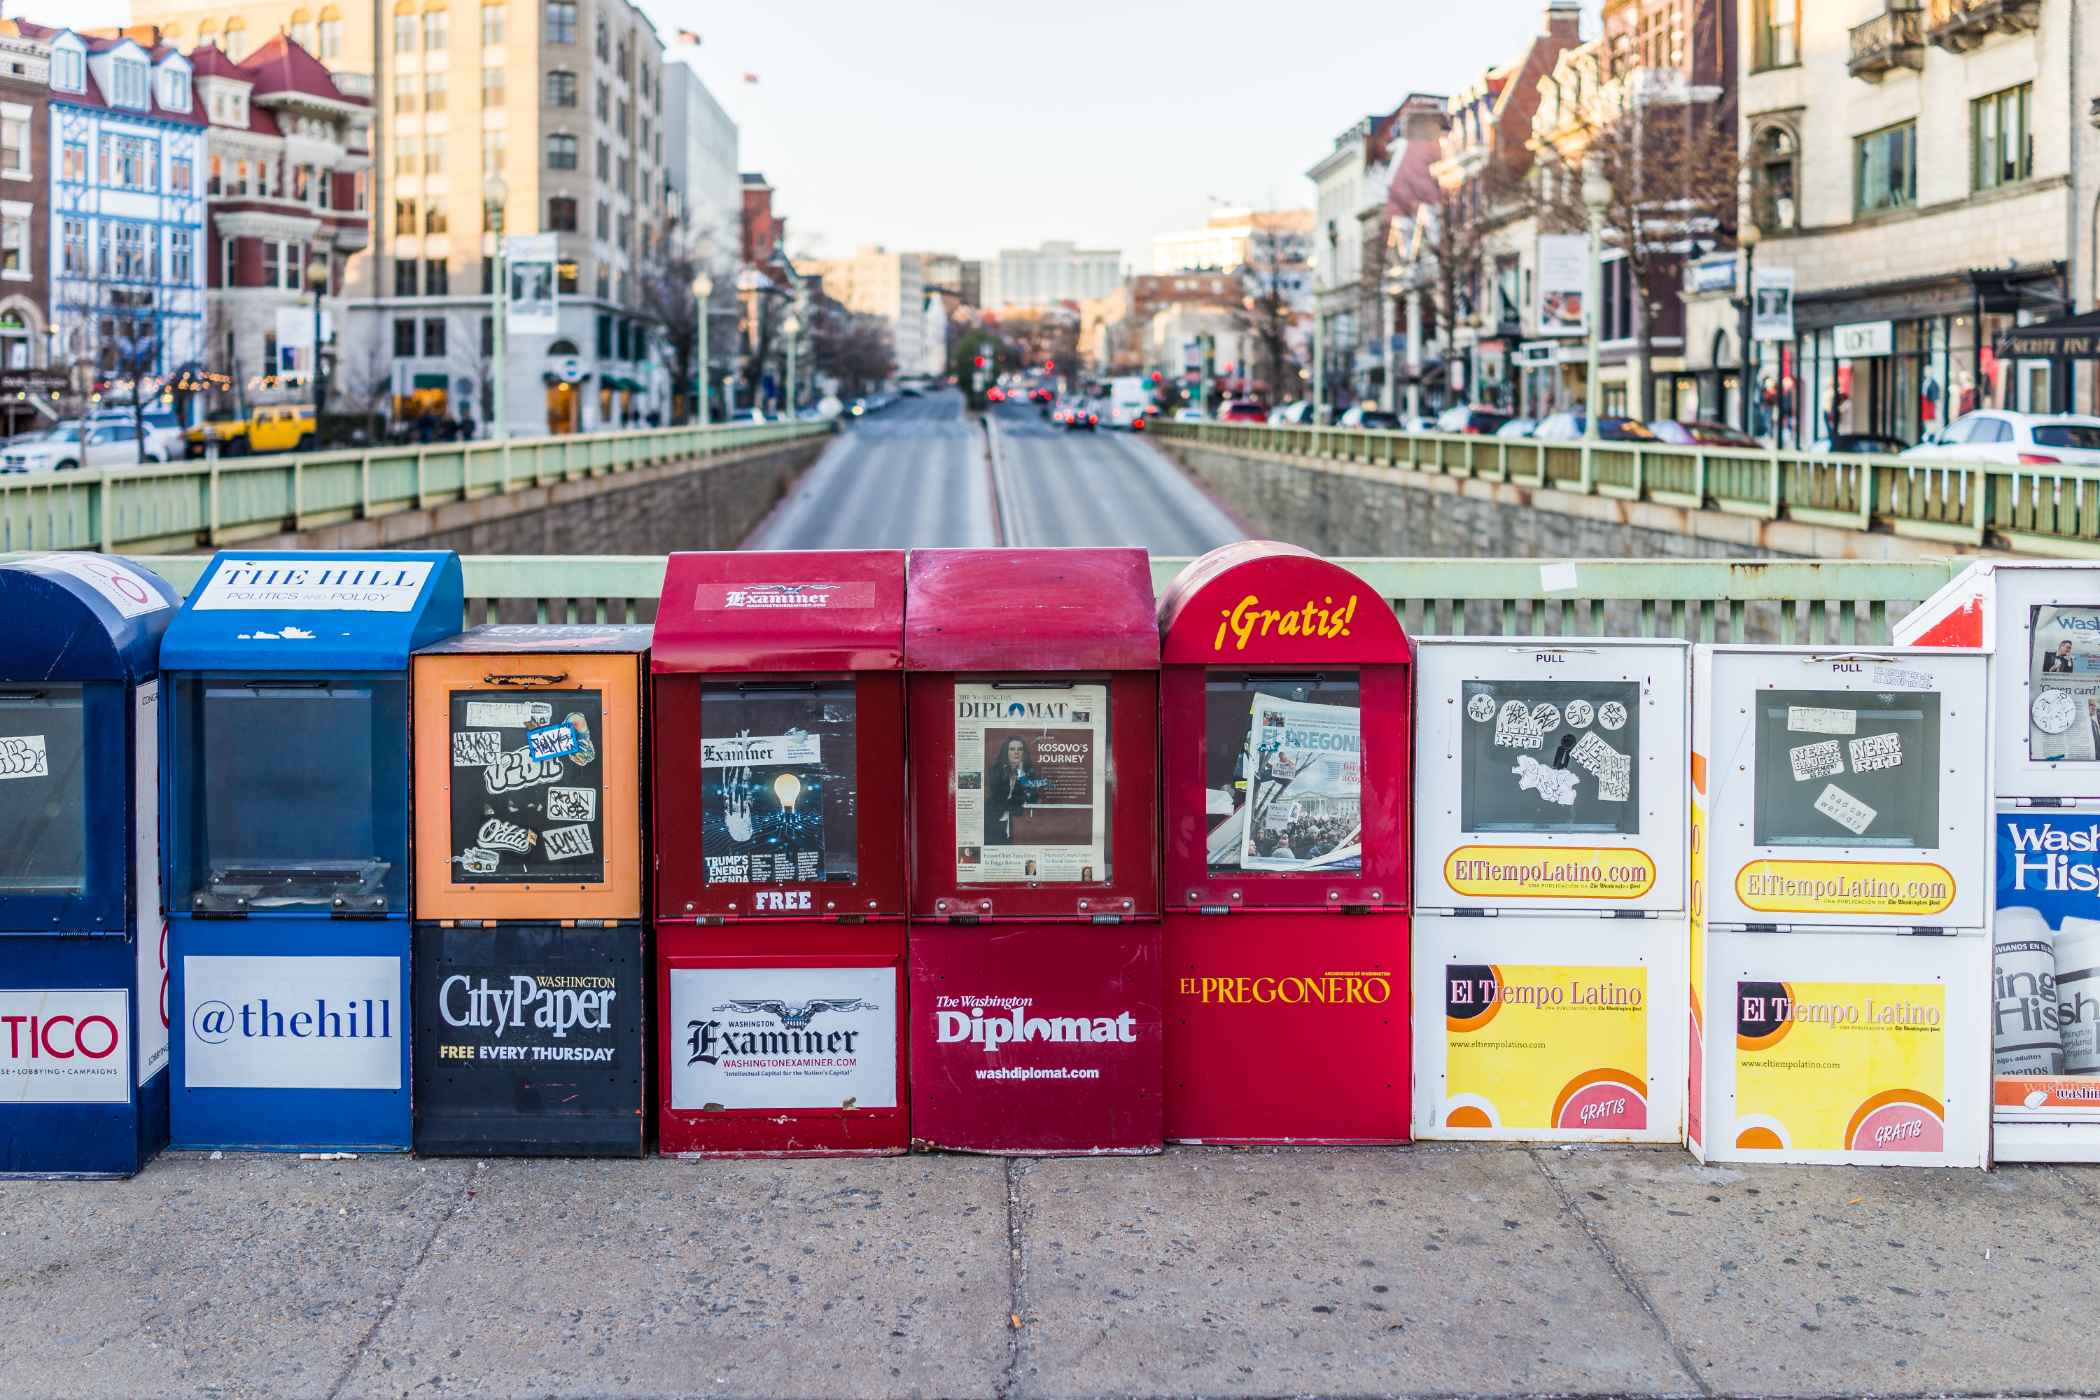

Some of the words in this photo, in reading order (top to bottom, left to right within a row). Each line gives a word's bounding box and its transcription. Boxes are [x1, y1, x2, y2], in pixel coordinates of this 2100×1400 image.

[225, 570, 309, 585] THE
[319, 570, 416, 587] HILL
[226, 591, 299, 600] POLITICS
[330, 592, 393, 601] POLICY
[725, 591, 830, 608] Examiner
[1214, 595, 1358, 650] ¡Gratis!
[1536, 654, 1565, 663] PULL
[1832, 663, 1863, 673] PULL
[959, 702, 1069, 719] DIPLOMAT
[1037, 743, 1089, 753] KOSOVO'S
[1850, 734, 1901, 760] NEAR
[1037, 754, 1085, 763] JOURNEY
[705, 855, 749, 867] TRUMP'S
[709, 866, 749, 876] ENERGY
[1455, 860, 1647, 885] ElTiempoLatino.com
[2013, 853, 2100, 898] His
[1747, 874, 1947, 900] ElTiempoLatino.com
[755, 891, 812, 910] FREE
[537, 976, 615, 989] WASHINGTON
[1179, 978, 1201, 994] EL
[1200, 977, 1391, 1004] PREGONERO
[936, 995, 958, 1008] The
[960, 995, 1033, 1010] Washington
[1450, 980, 1475, 1004] El
[1479, 980, 1564, 1009] Tiempo
[1570, 981, 1642, 1006] Latino
[192, 998, 392, 1045] @thehill
[1741, 997, 1766, 1022] El
[1771, 997, 1860, 1029] Tiempo
[1864, 998, 1941, 1026] Latino
[0, 1014, 119, 1060] TICO
[935, 1007, 1137, 1052] Diplomat
[687, 1019, 860, 1067] Examiner
[1450, 1040, 1547, 1049] www.eltiempolatino.com
[440, 1045, 475, 1059] FREE
[479, 1046, 528, 1060] EVERY
[532, 1047, 615, 1062] THURSDAY
[722, 1058, 857, 1068] WASHINGTONEXAMINER.COM
[1740, 1058, 1841, 1070] www.eltiempolatino.com
[975, 1067, 1100, 1081] washdiplomat.com
[1580, 1098, 1626, 1124] GRATIS
[1874, 1119, 1923, 1148] GRATIS
